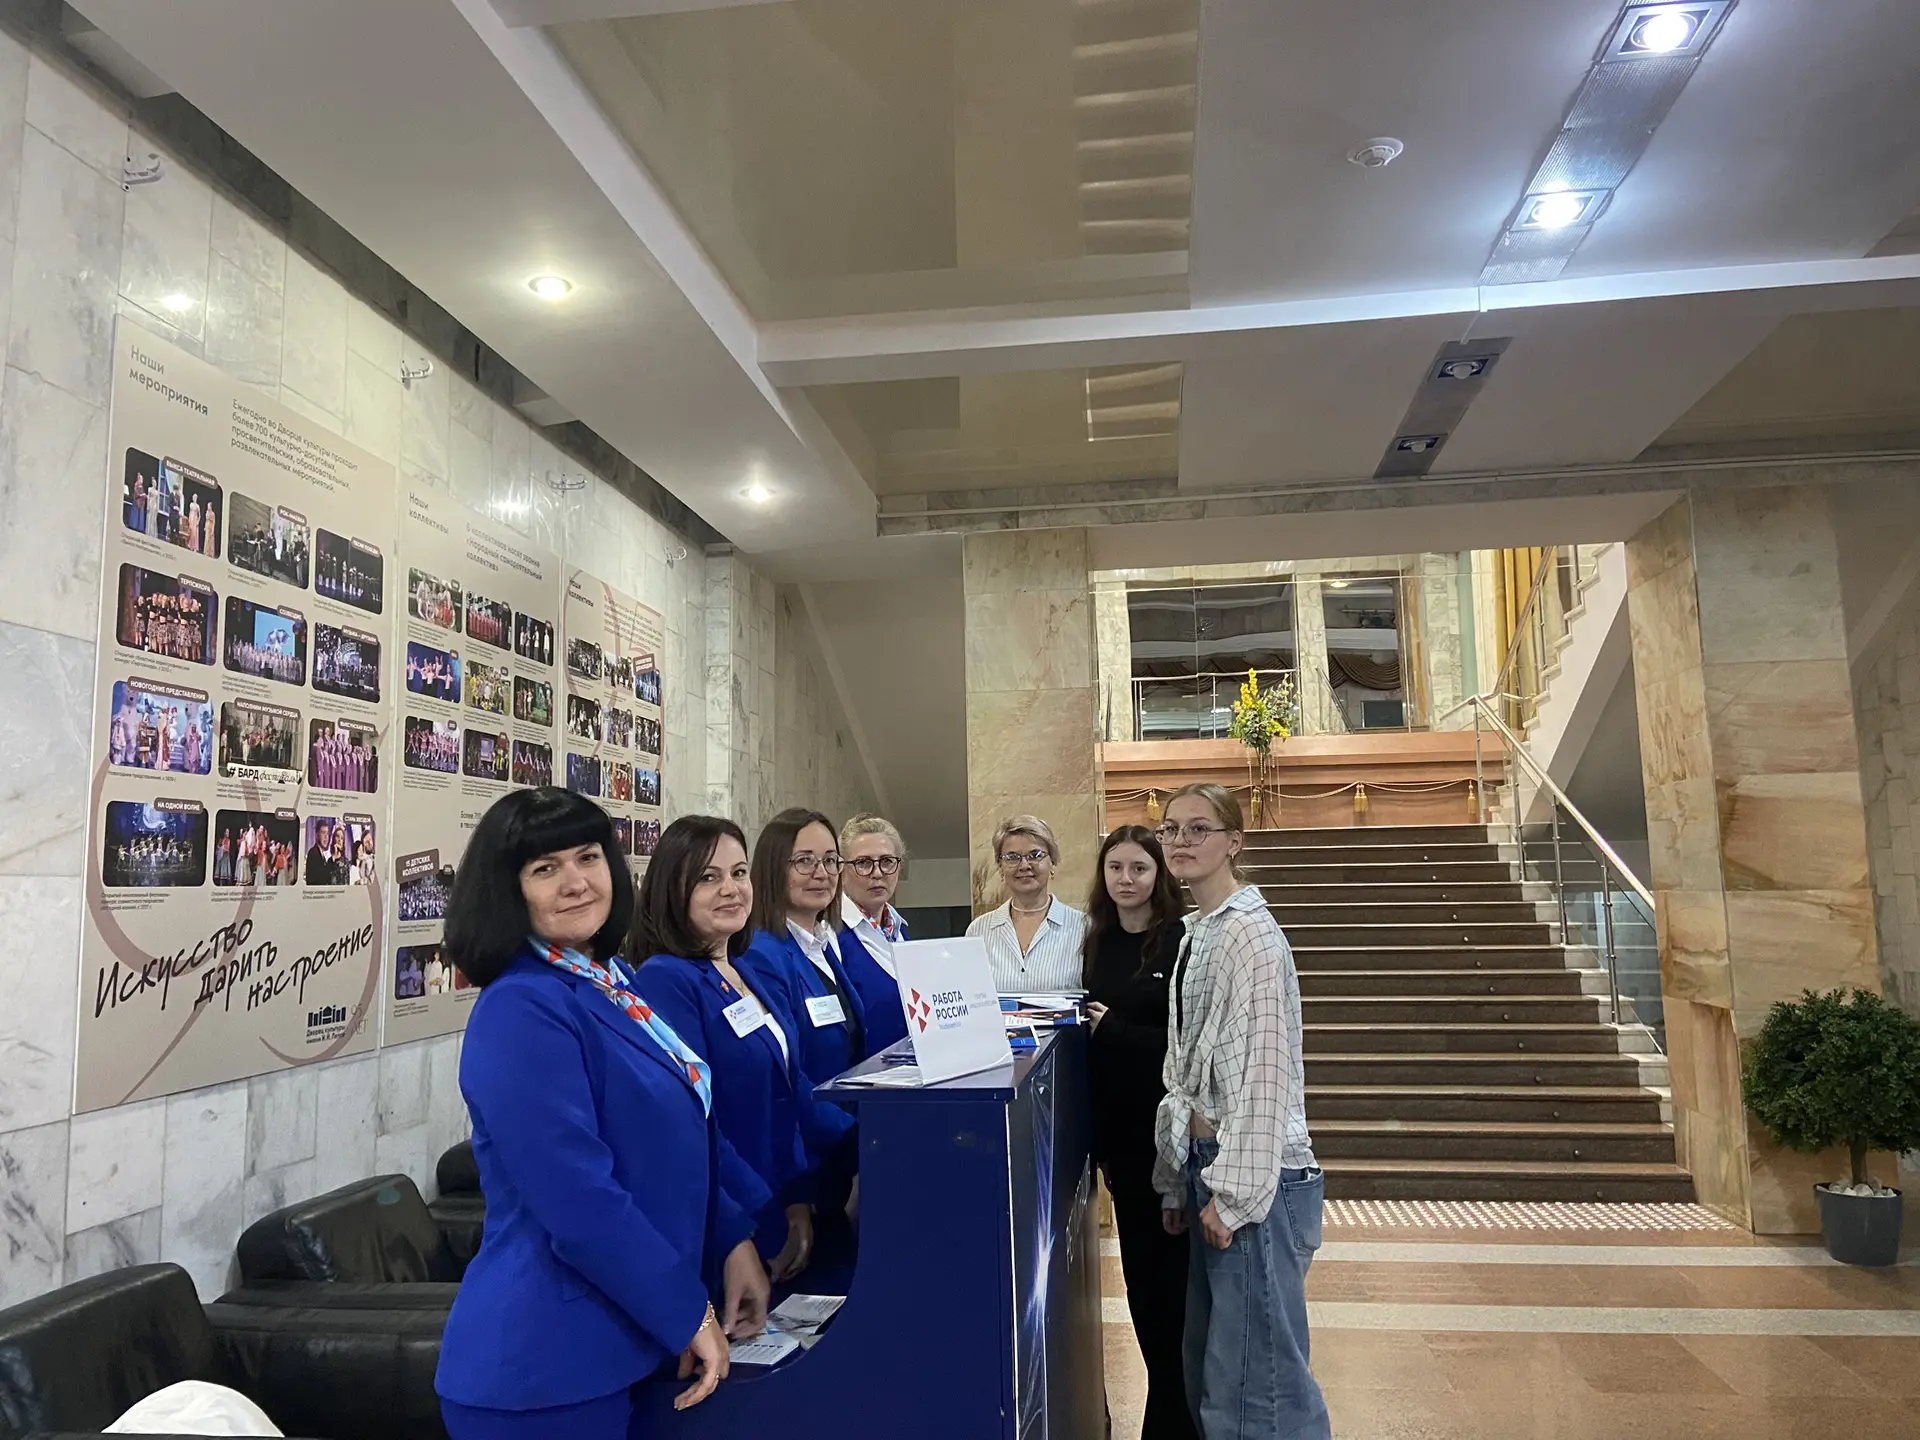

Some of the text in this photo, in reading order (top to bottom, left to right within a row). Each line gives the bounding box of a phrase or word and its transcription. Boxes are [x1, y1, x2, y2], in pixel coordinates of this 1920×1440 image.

[131, 345, 164, 374] Наши
[129, 368, 208, 415] мероприятия
[232, 411, 254, 430] более
[255, 423, 268, 437] 700
[233, 398, 267, 424] Ежегодно
[268, 419, 277, 429] во
[278, 422, 302, 442] Дворце
[303, 438, 331, 459] культуры
[231, 438, 291, 472] развлекательных
[409, 492, 429, 511] Наши
[130, 680, 206, 700] НОВОГОДНИЕ ПРЕДСТАВЛЕНИЯ
[165, 801, 183, 810] ОДНОЙ
[183, 803, 200, 811] ВОЛНЕ
[402, 862, 434, 877] КОЛЛЕКТИВОВ
[94, 918, 254, 1019] Искусство
[246, 923, 375, 1012] настроение
[931, 990, 964, 1006] РАБОТА
[935, 1004, 969, 1020] РОССИИ
